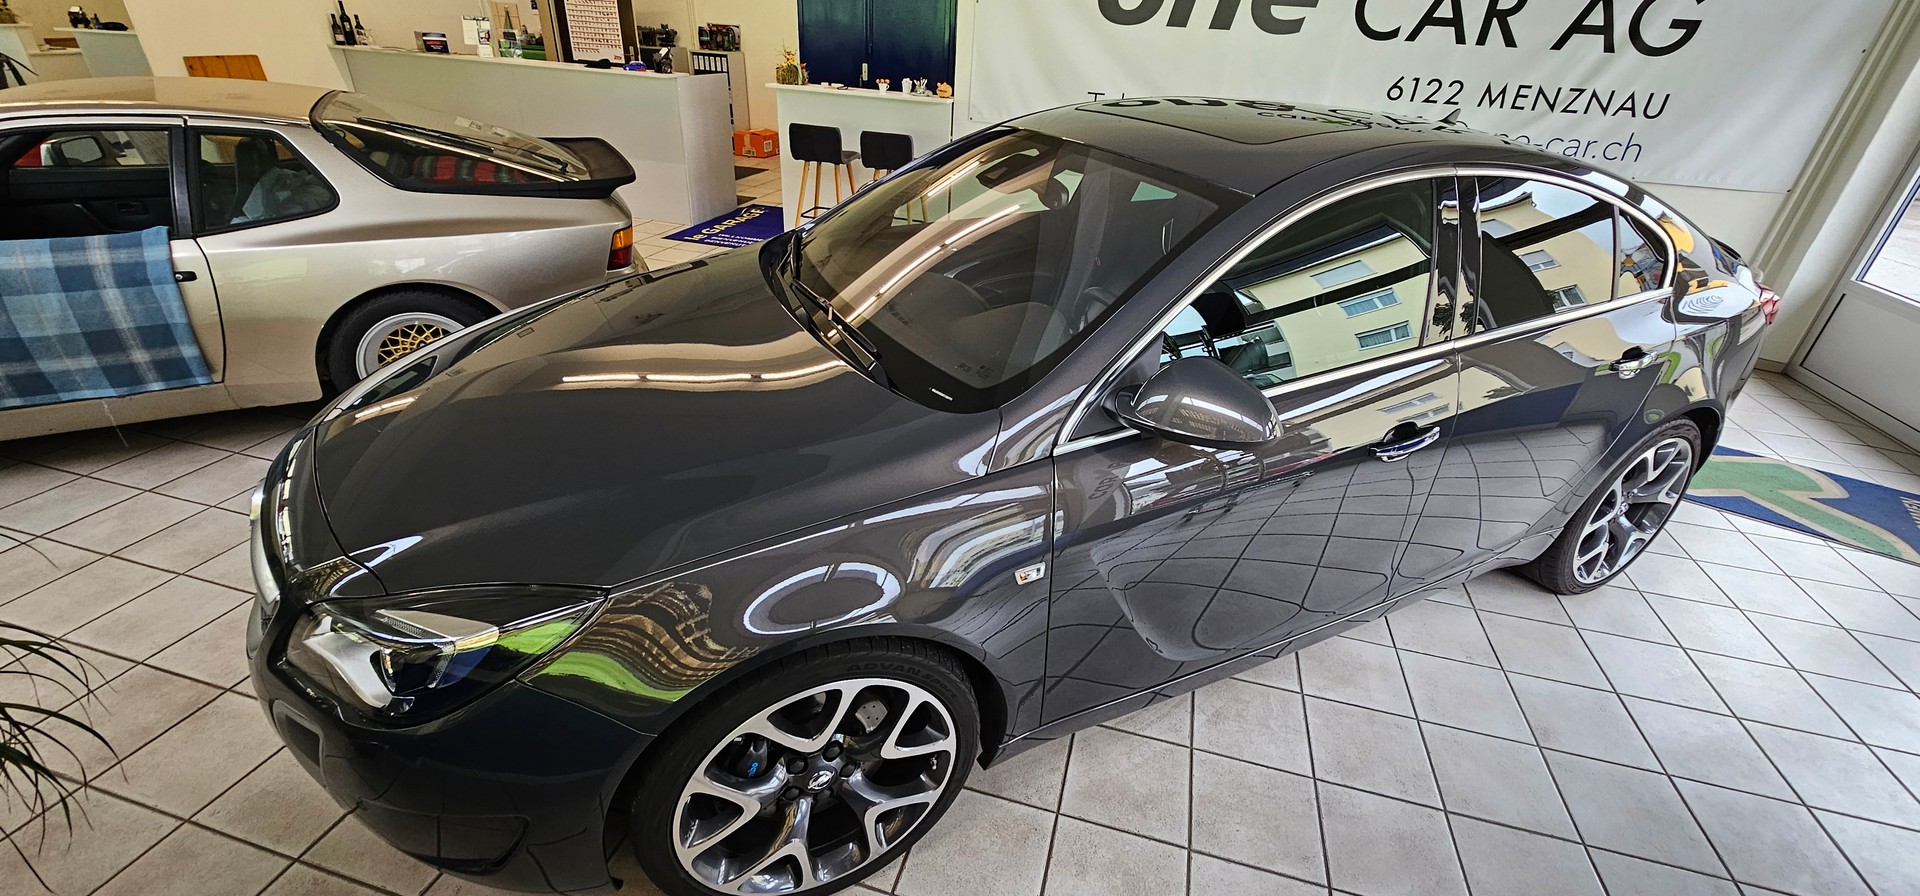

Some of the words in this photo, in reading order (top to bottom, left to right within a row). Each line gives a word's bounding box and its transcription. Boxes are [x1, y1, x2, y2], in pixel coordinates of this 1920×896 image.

[1354, 0, 1529, 48] CAR
[1549, 0, 1706, 57] AG
[1386, 75, 1465, 105] 6122
[1477, 81, 1671, 120] MENZNAU
[701, 207, 766, 235] GARAGE
[846, 662, 920, 676] ADVAN
